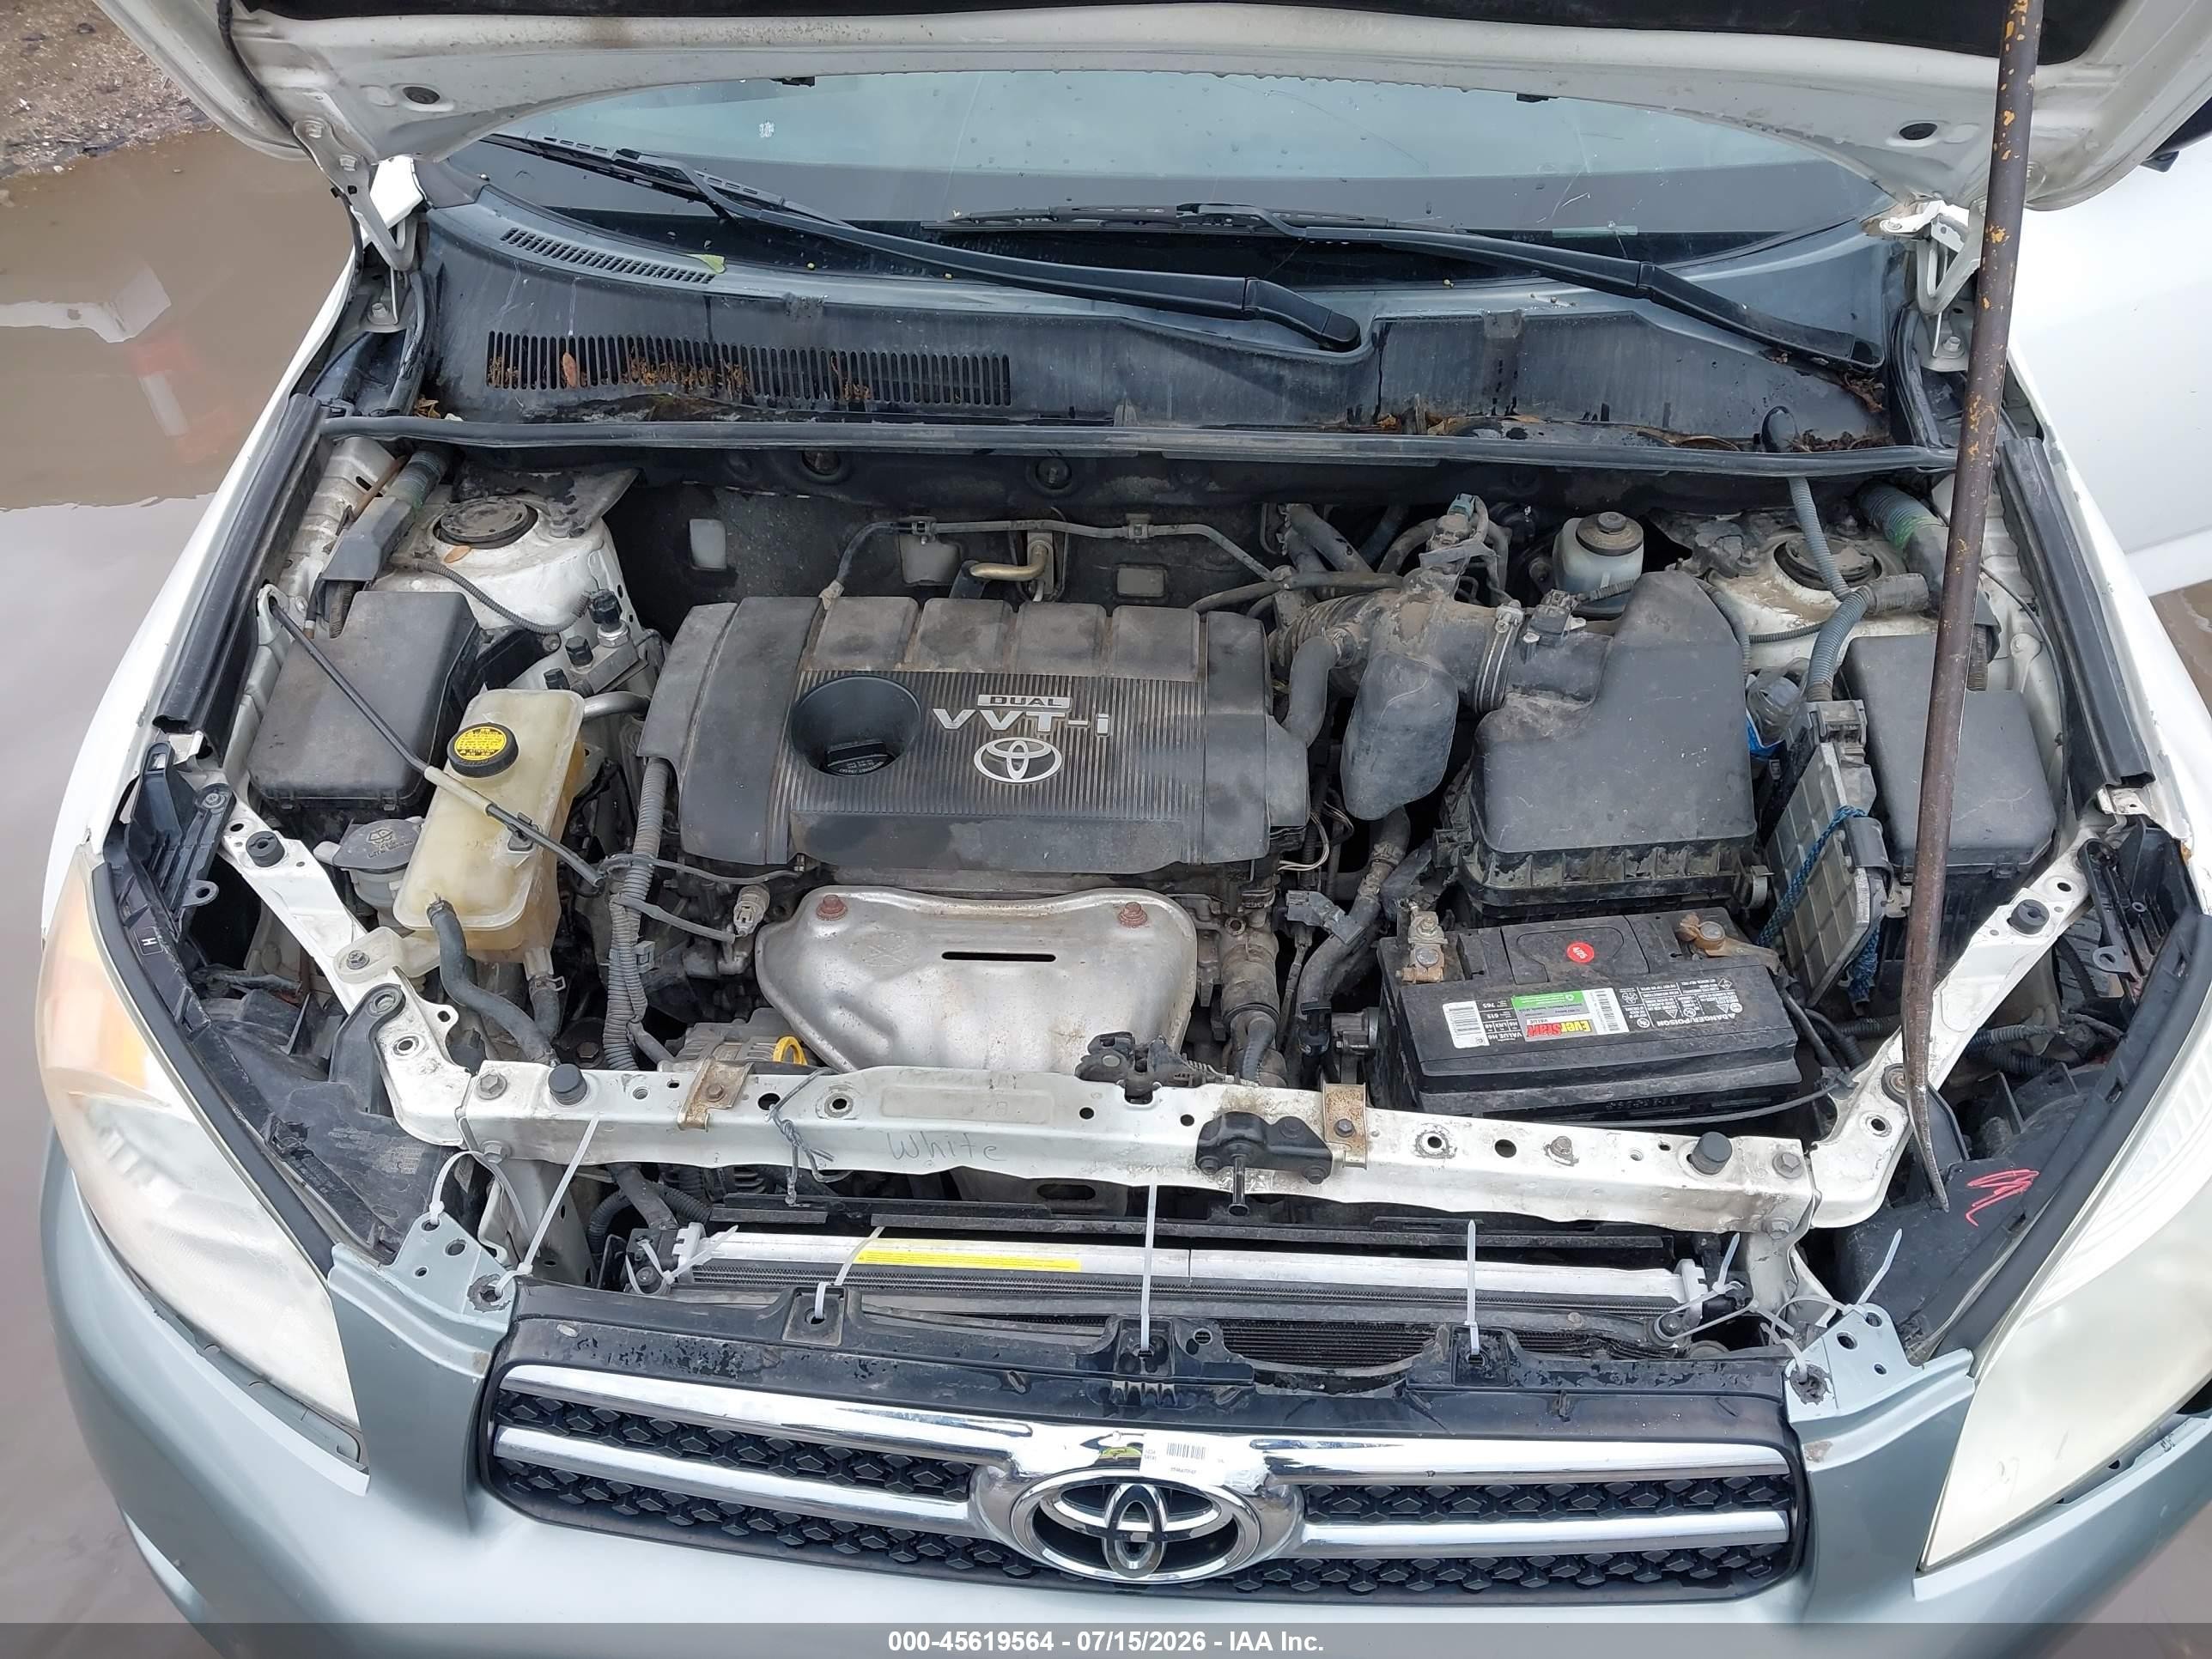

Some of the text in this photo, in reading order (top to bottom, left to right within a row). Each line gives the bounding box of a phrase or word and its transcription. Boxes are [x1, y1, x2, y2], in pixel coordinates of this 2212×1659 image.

[989, 696, 1062, 707] DUAL
[933, 708, 1109, 735] VVT-i
[1527, 1021, 1591, 1037] EverStart
[886, 1130, 1007, 1162] White
